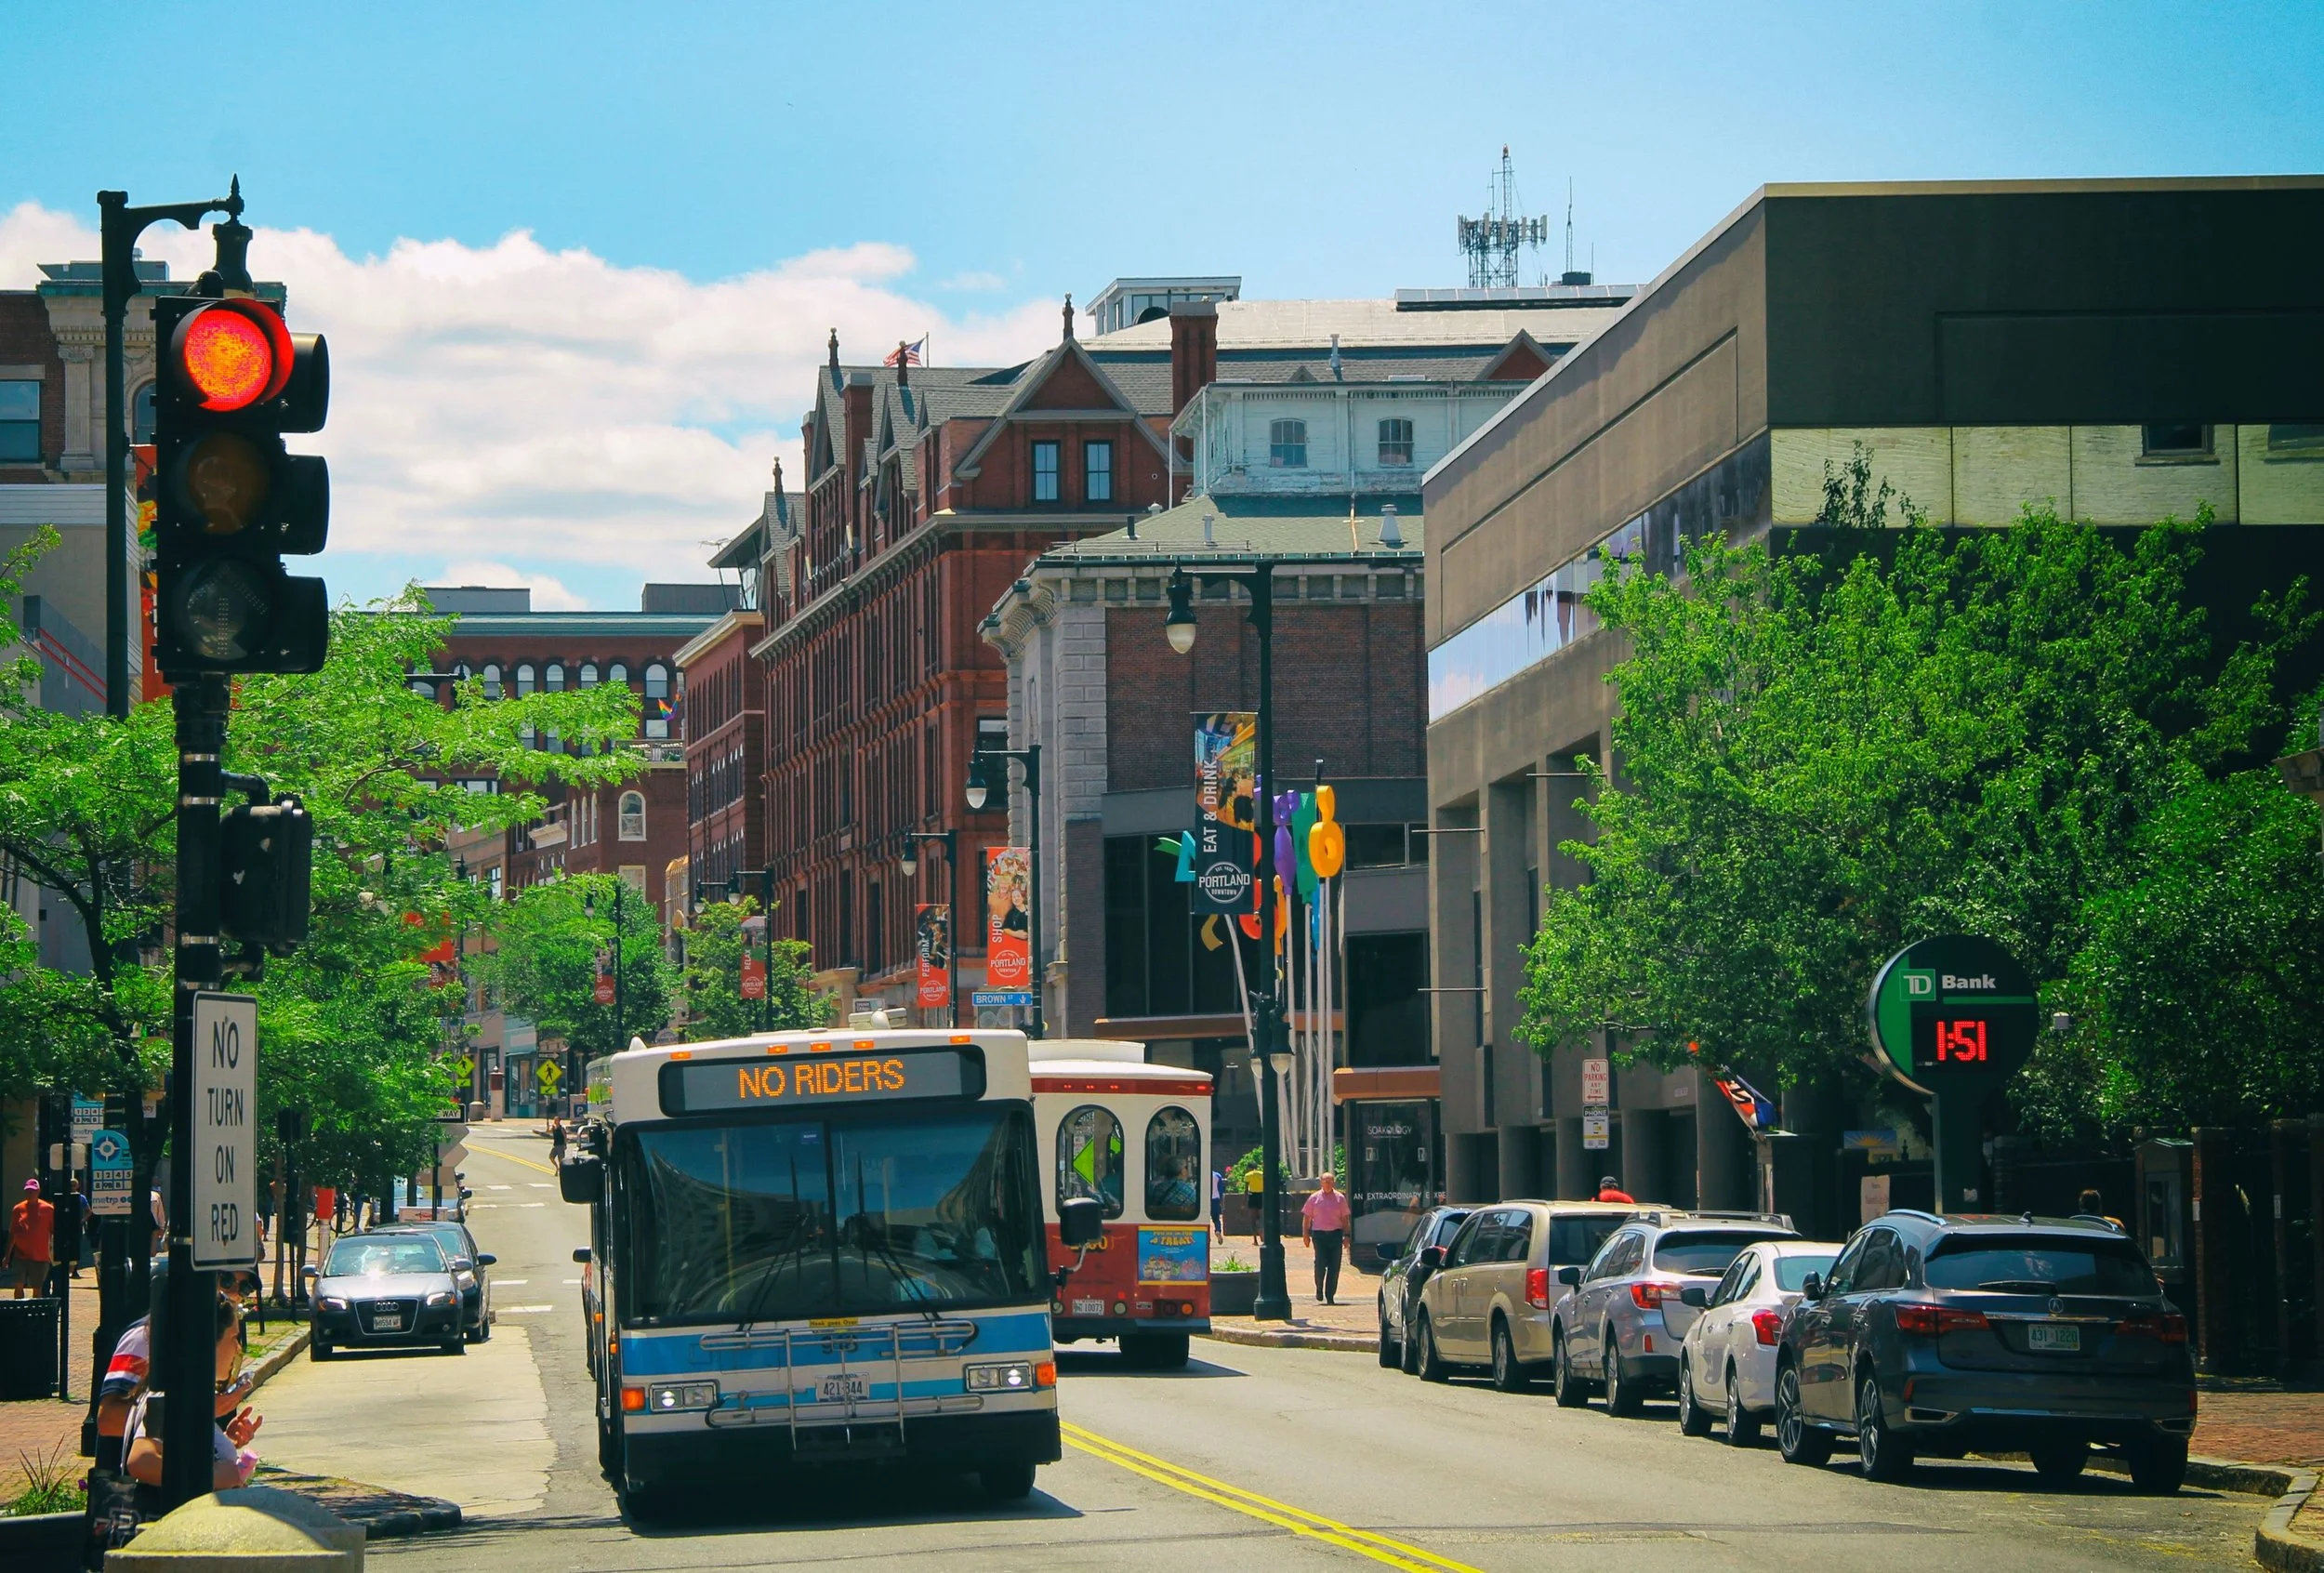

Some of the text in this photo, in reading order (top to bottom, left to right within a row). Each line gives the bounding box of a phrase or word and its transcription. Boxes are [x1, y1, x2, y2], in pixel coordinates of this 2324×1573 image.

[1203, 760, 1218, 853] EAT & DRINK
[1198, 874, 1250, 888] PORTLAND
[992, 914, 1003, 943] SHOP
[990, 958, 1025, 968] PORTLAND
[1903, 974, 1996, 994] TD Bank
[977, 995, 1006, 1003] BROWN
[212, 1020, 239, 1069] NO
[1936, 1021, 1987, 1061] 1:51
[738, 1059, 905, 1099] NO RIDERS
[1591, 1064, 1600, 1072] NO
[207, 1088, 244, 1126] TURN
[442, 1109, 459, 1117] WAY
[1367, 1125, 1412, 1134] SOAKOLOGY
[215, 1144, 234, 1184] ON
[93, 1196, 118, 1205] metro
[211, 1203, 238, 1242] RED
